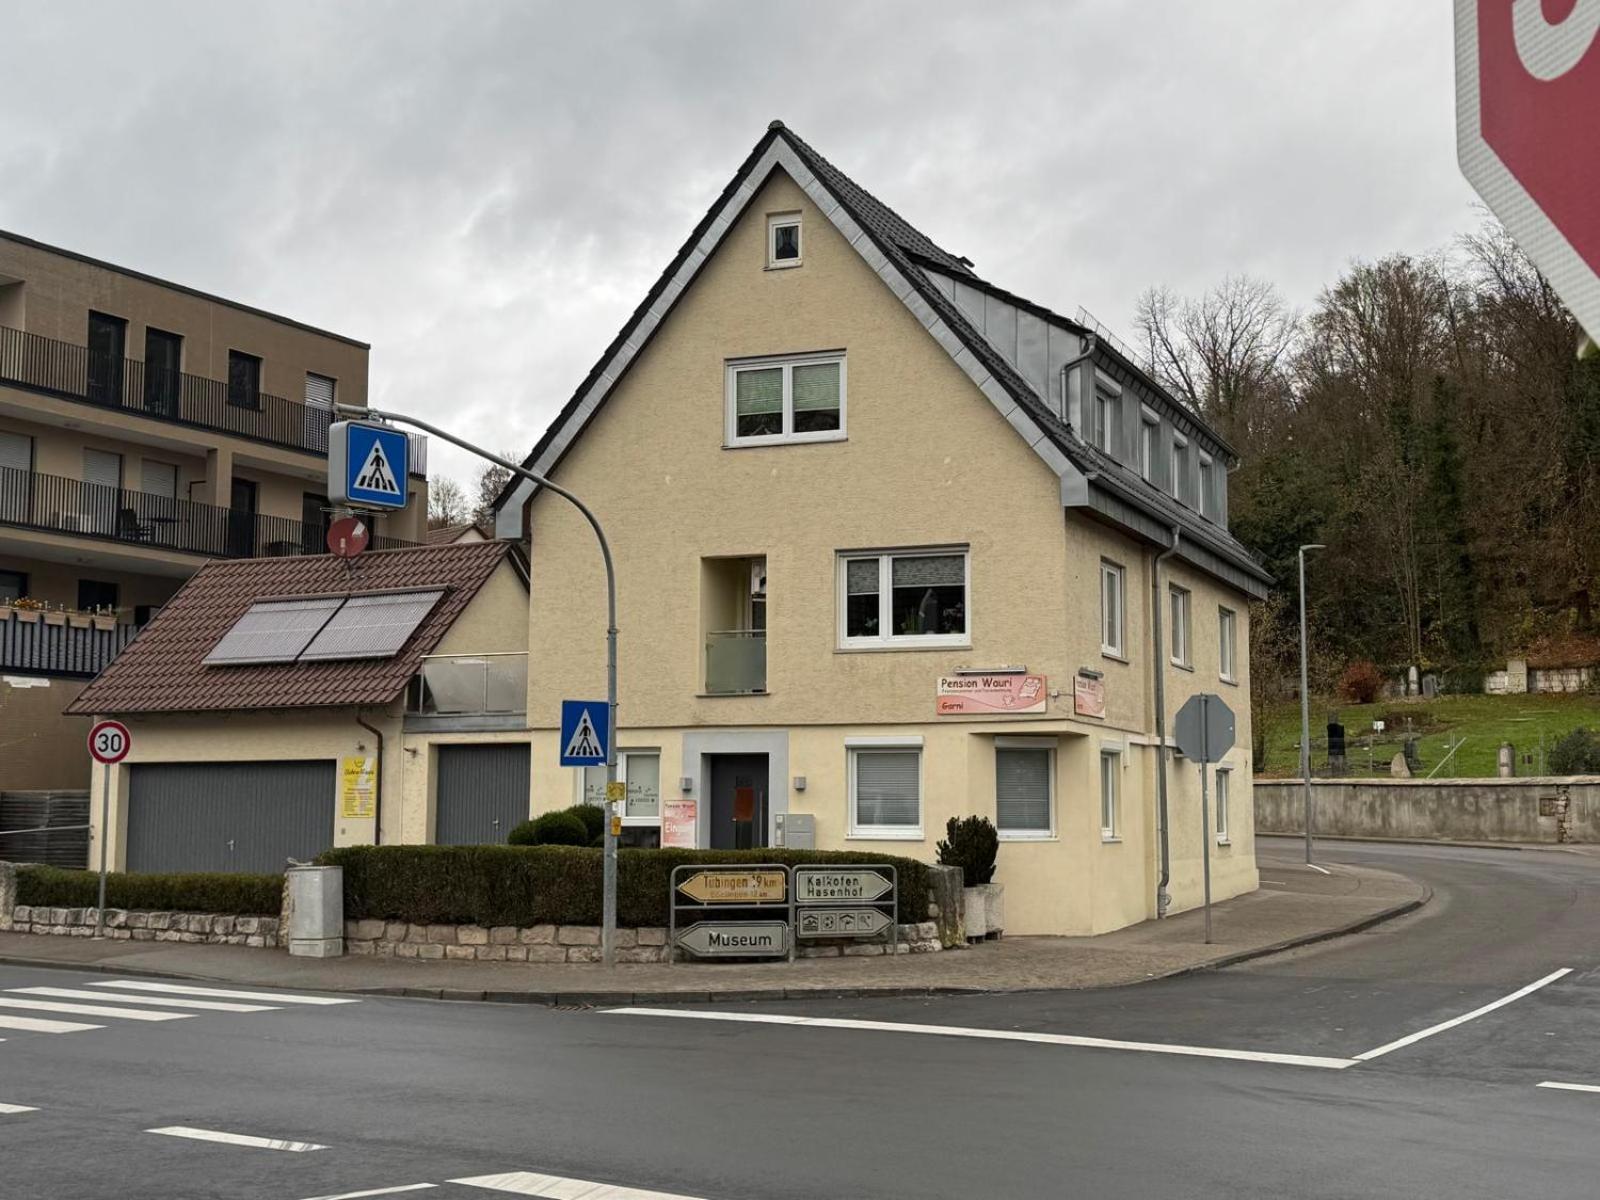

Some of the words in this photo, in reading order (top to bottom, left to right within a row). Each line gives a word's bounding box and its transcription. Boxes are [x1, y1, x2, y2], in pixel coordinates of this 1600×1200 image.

[942, 678, 978, 688] Pension
[98, 733, 122, 752] 30
[764, 877, 777, 888] km
[807, 875, 859, 886] Kalkofen
[807, 886, 863, 896] Hasenhof
[709, 933, 772, 946] Museum
